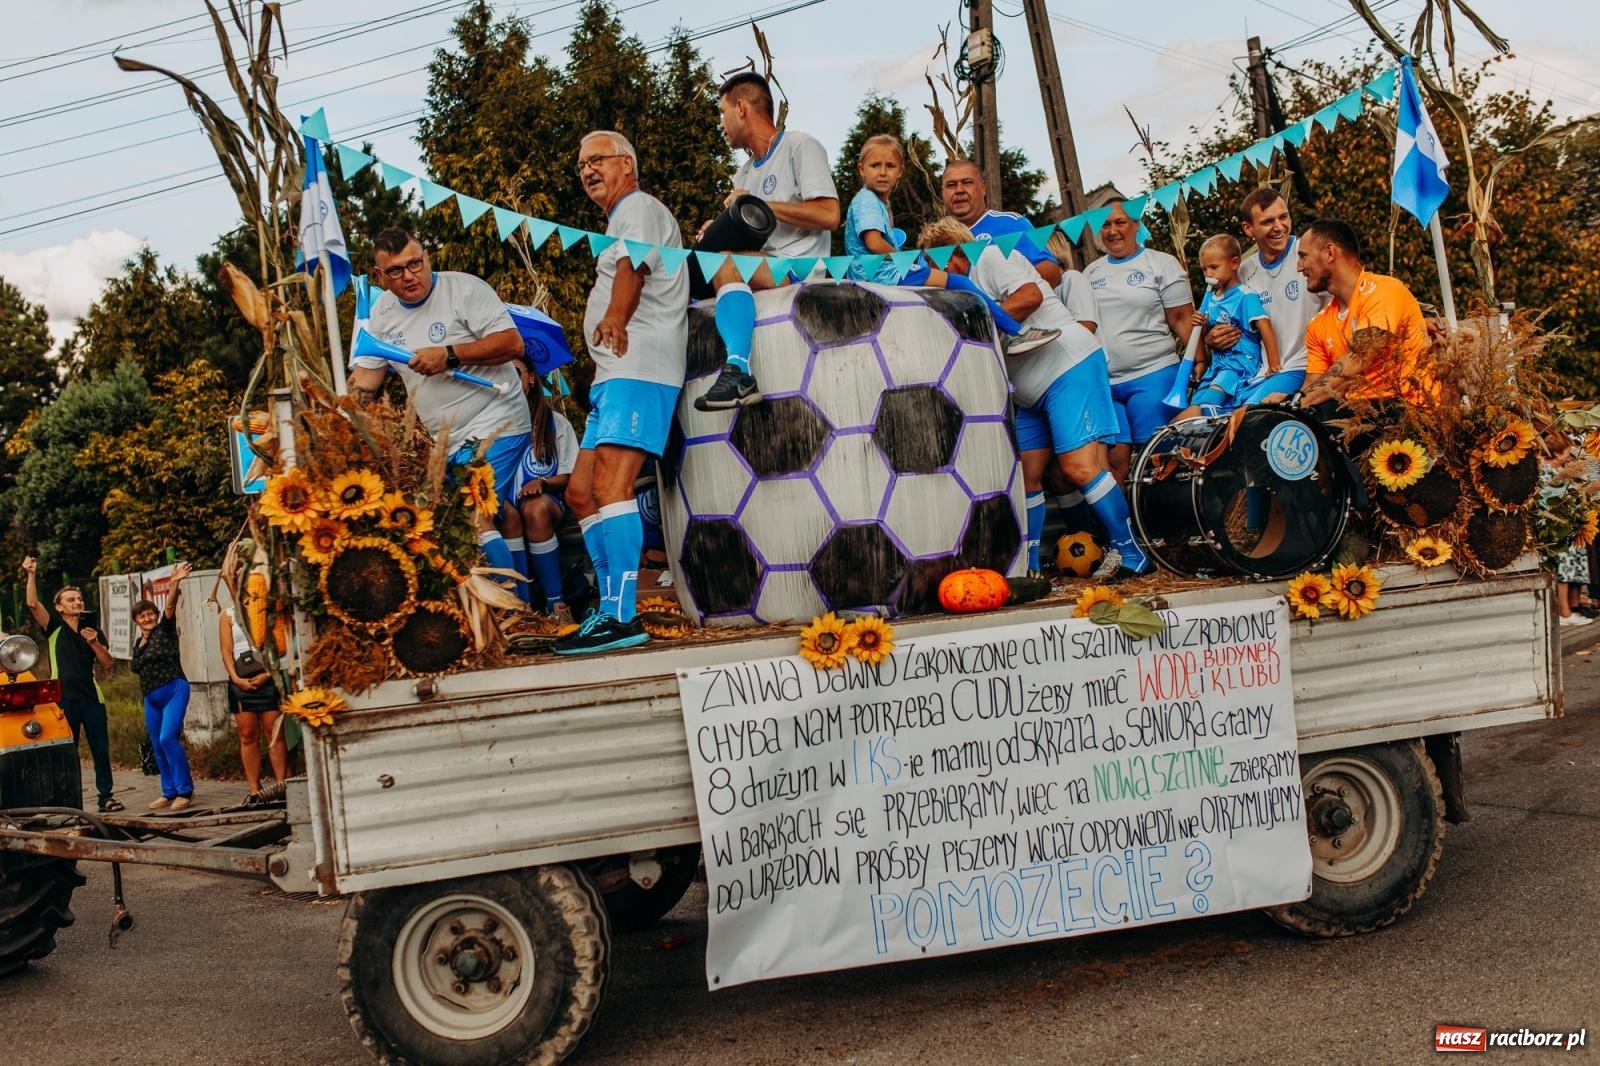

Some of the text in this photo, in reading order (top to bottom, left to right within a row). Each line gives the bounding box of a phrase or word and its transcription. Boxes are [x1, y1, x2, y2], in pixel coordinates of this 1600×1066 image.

[1277, 428, 1312, 465] LKS
[1285, 447, 1298, 461] 07
[1040, 624, 1068, 666] MY
[950, 674, 1024, 720] CUDU
[1211, 664, 1281, 697] KLUBU
[708, 767, 737, 815] 8
[741, 763, 818, 808] drużyn
[715, 879, 744, 915] DO
[1183, 840, 1214, 915] ?
